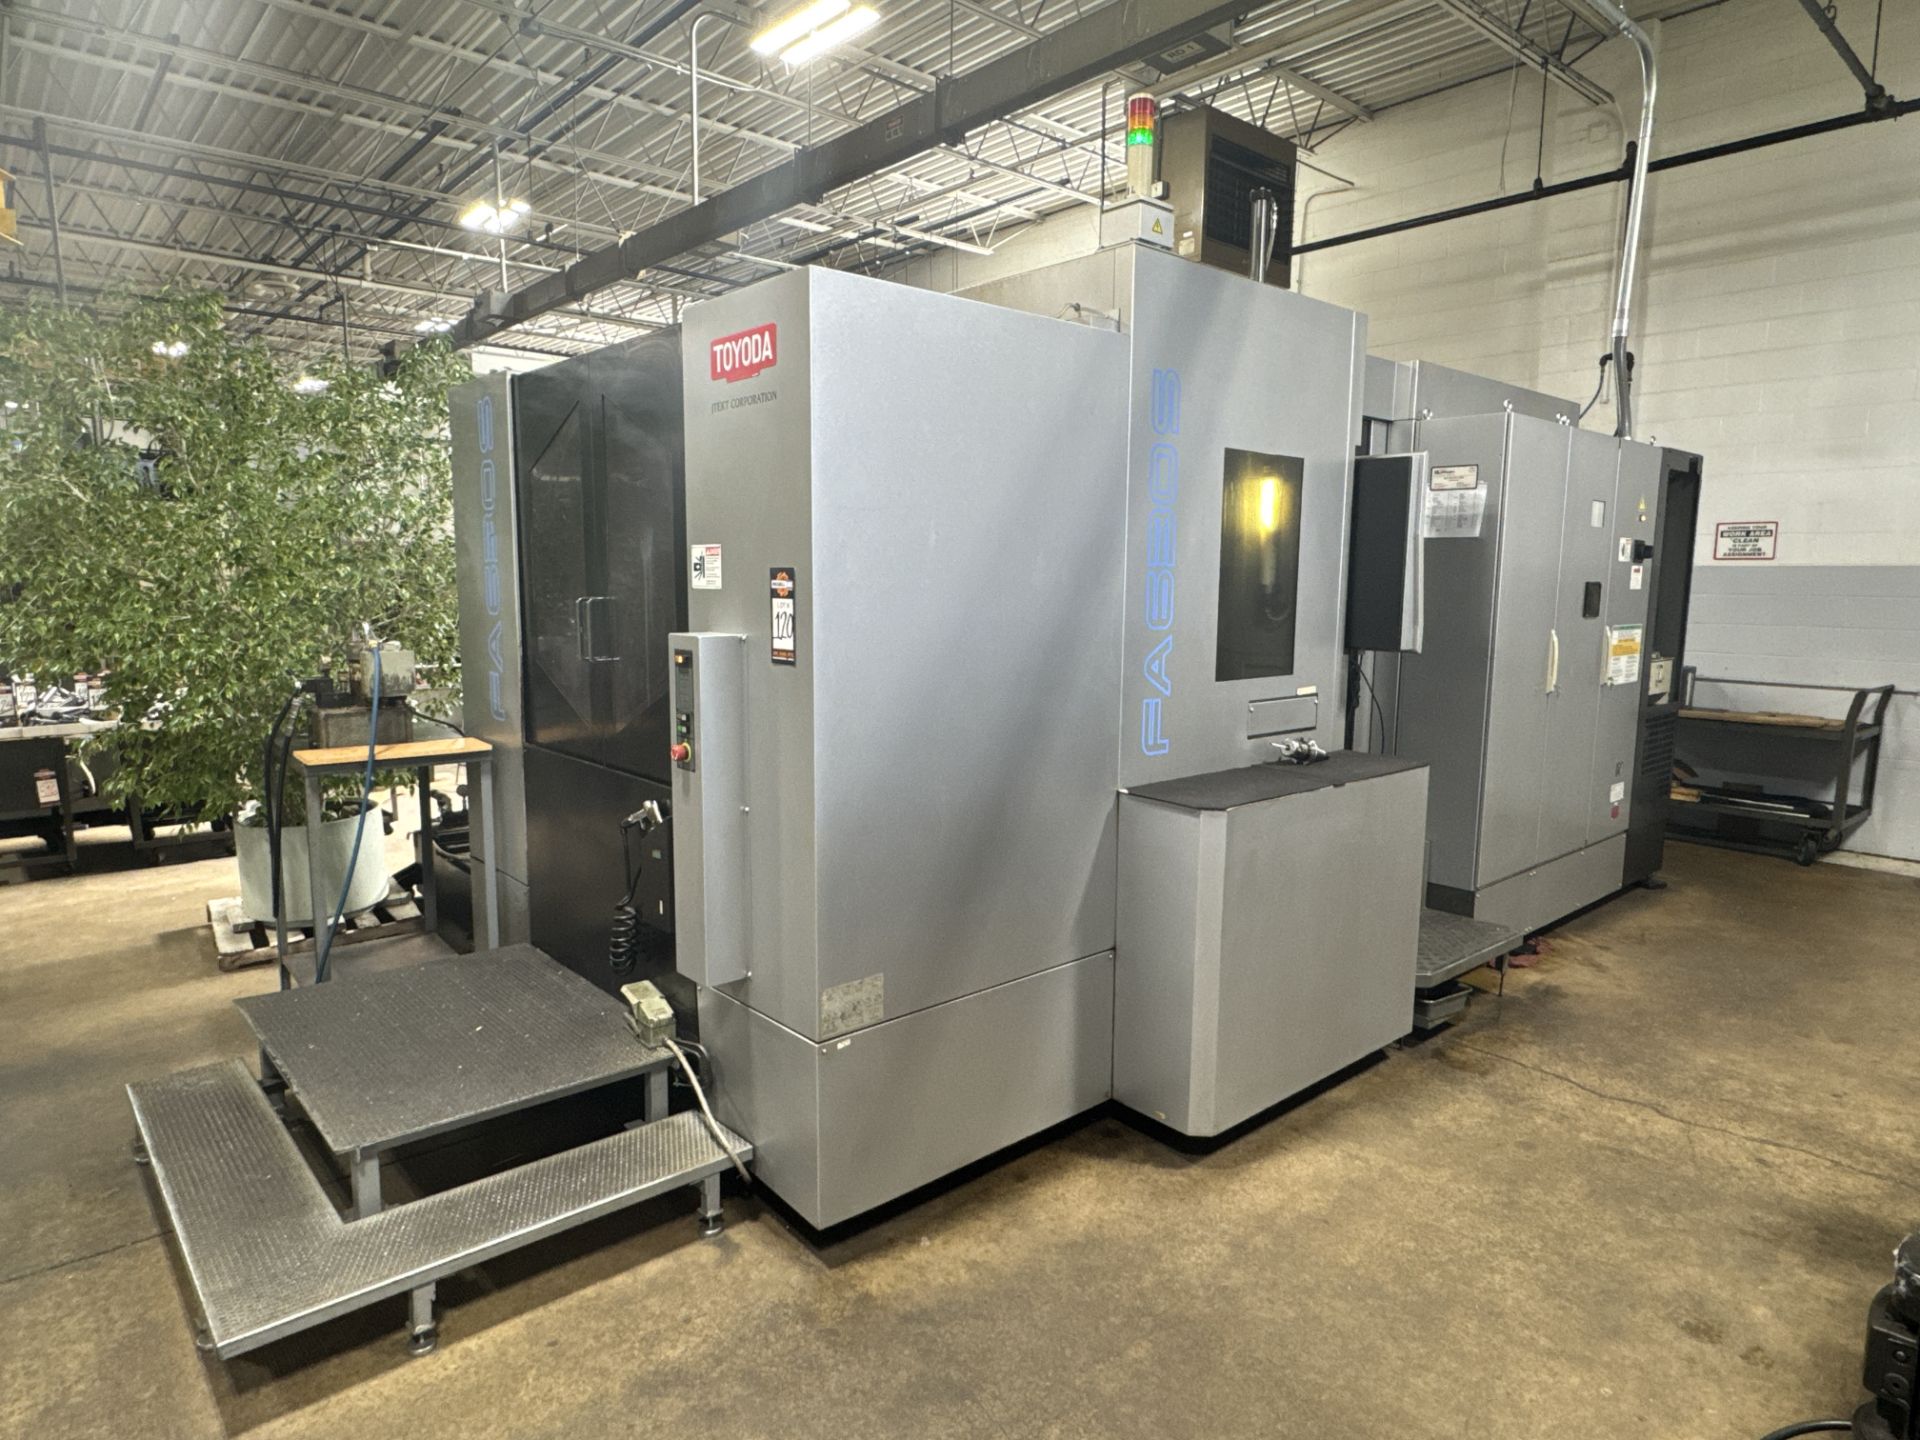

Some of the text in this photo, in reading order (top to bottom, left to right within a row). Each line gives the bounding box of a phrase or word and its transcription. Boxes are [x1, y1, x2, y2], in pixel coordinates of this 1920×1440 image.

[712, 330, 774, 373] TOYODA
[730, 391, 777, 410] CORPORATION
[1141, 368, 1182, 757] FA630S
[774, 611, 795, 640] 120
